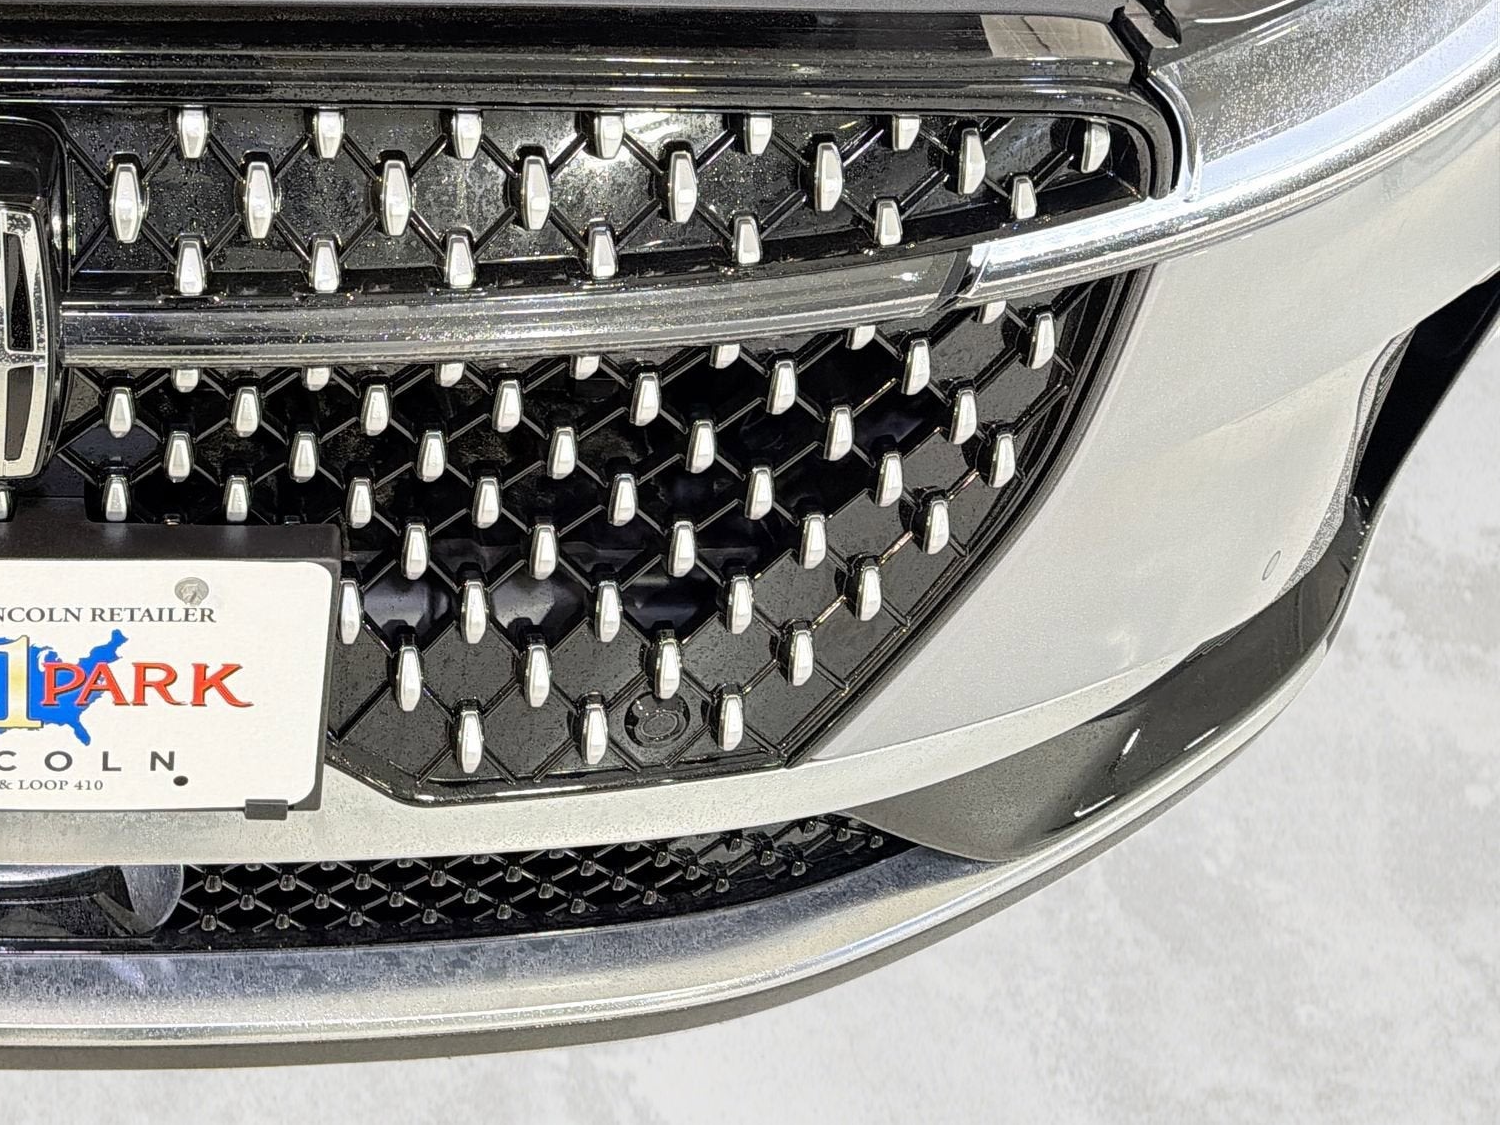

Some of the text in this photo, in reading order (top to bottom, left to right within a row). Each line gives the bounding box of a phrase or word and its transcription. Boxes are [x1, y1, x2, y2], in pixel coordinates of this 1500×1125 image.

[89, 607, 217, 624] RETAILER
[40, 661, 255, 707] PARK
[17, 779, 69, 791] LOOP
[73, 779, 104, 791] 410
